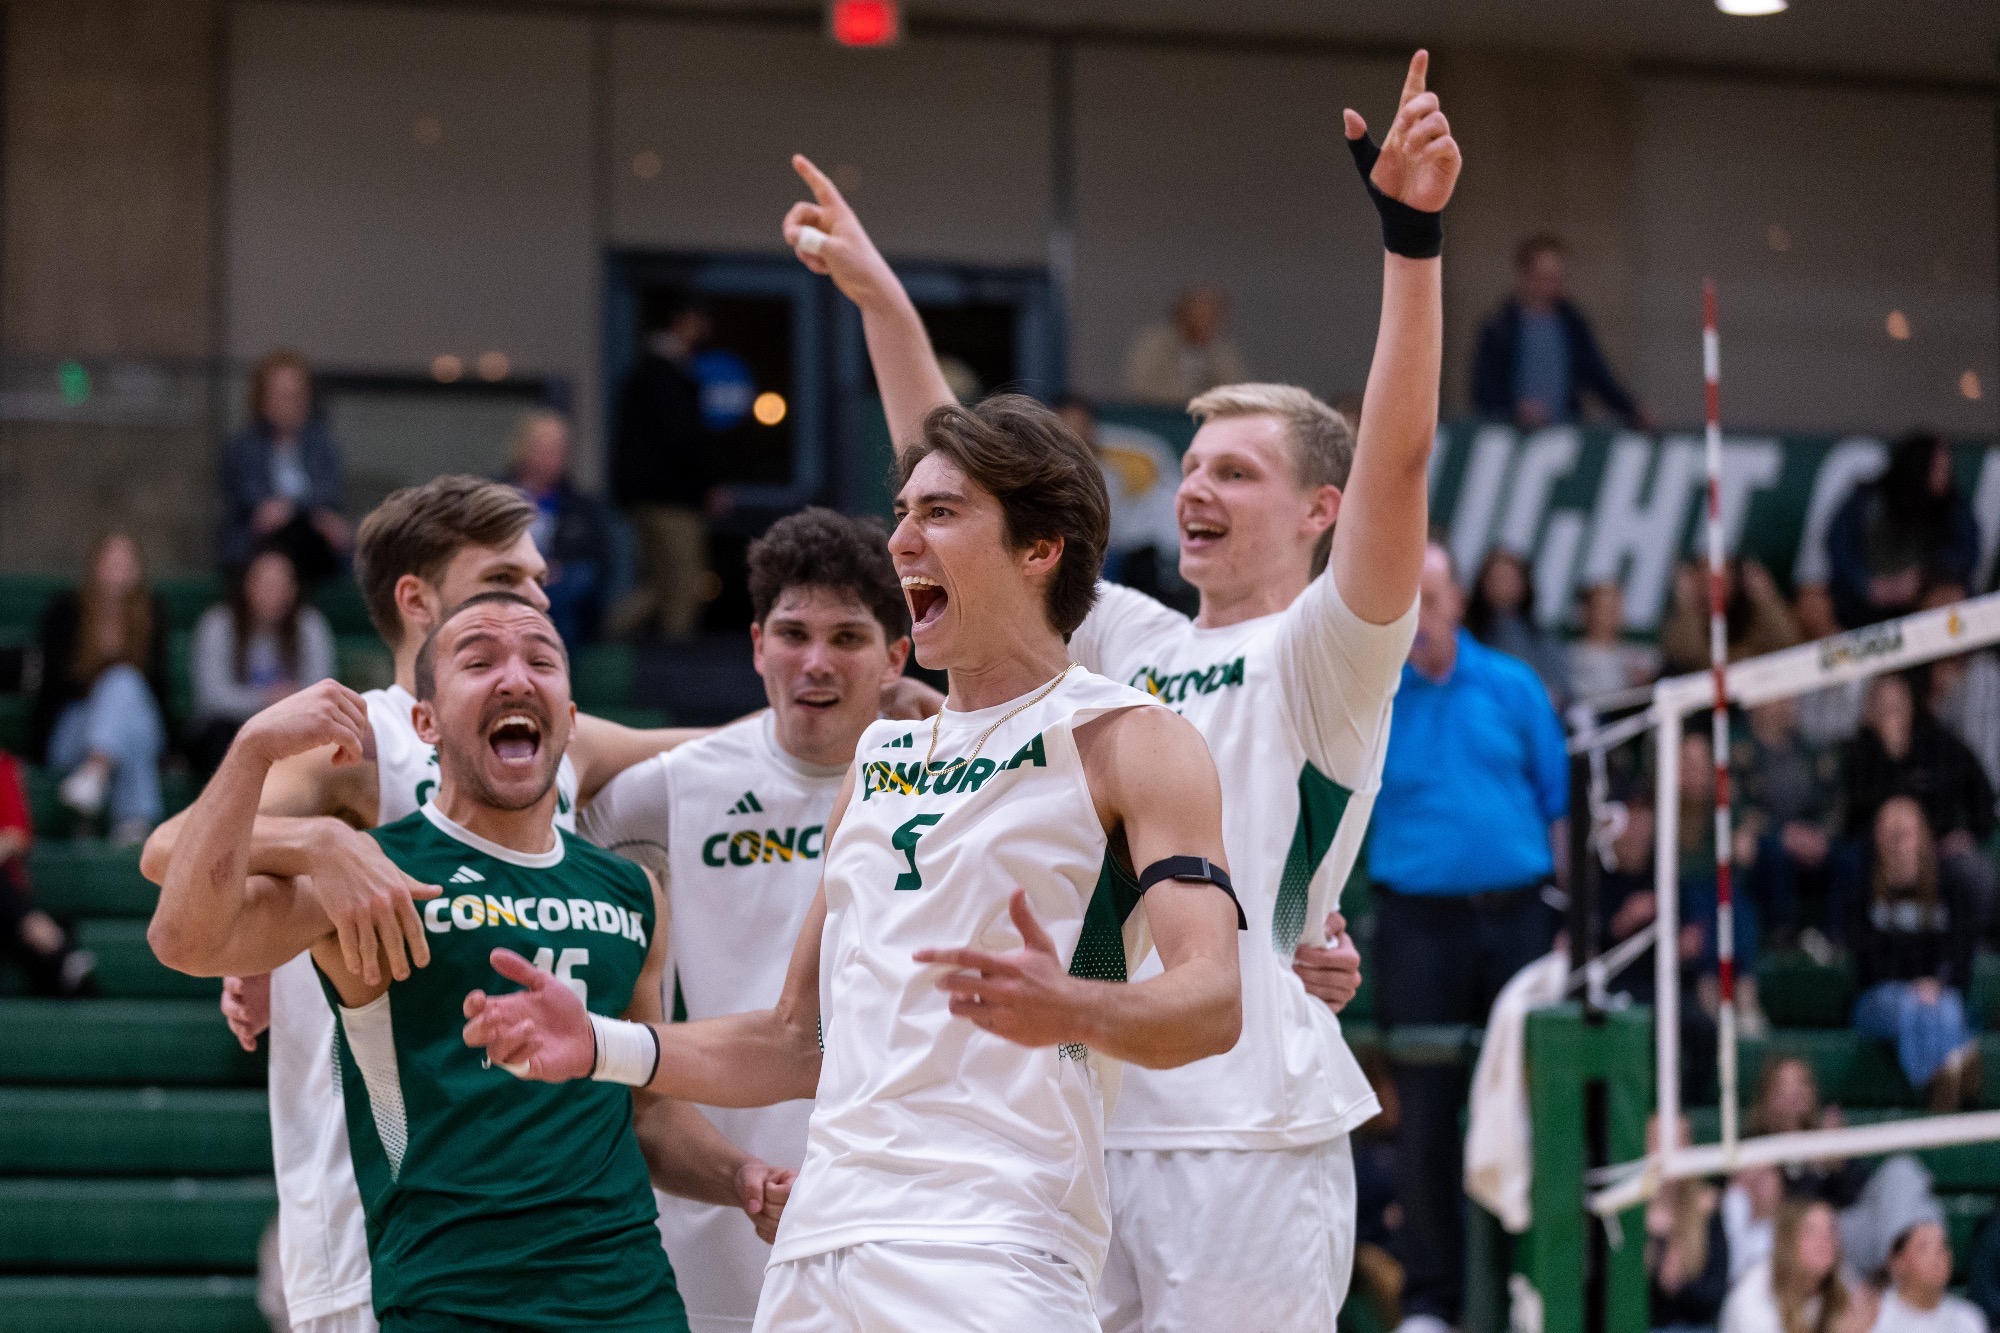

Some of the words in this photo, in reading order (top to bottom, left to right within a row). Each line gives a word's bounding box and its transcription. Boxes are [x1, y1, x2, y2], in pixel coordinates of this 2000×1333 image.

[1428, 426, 1783, 632] IGHT
[863, 732, 1047, 801] ONCORA
[702, 824, 826, 868] CONC
[424, 895, 647, 948] CONCORDIA
